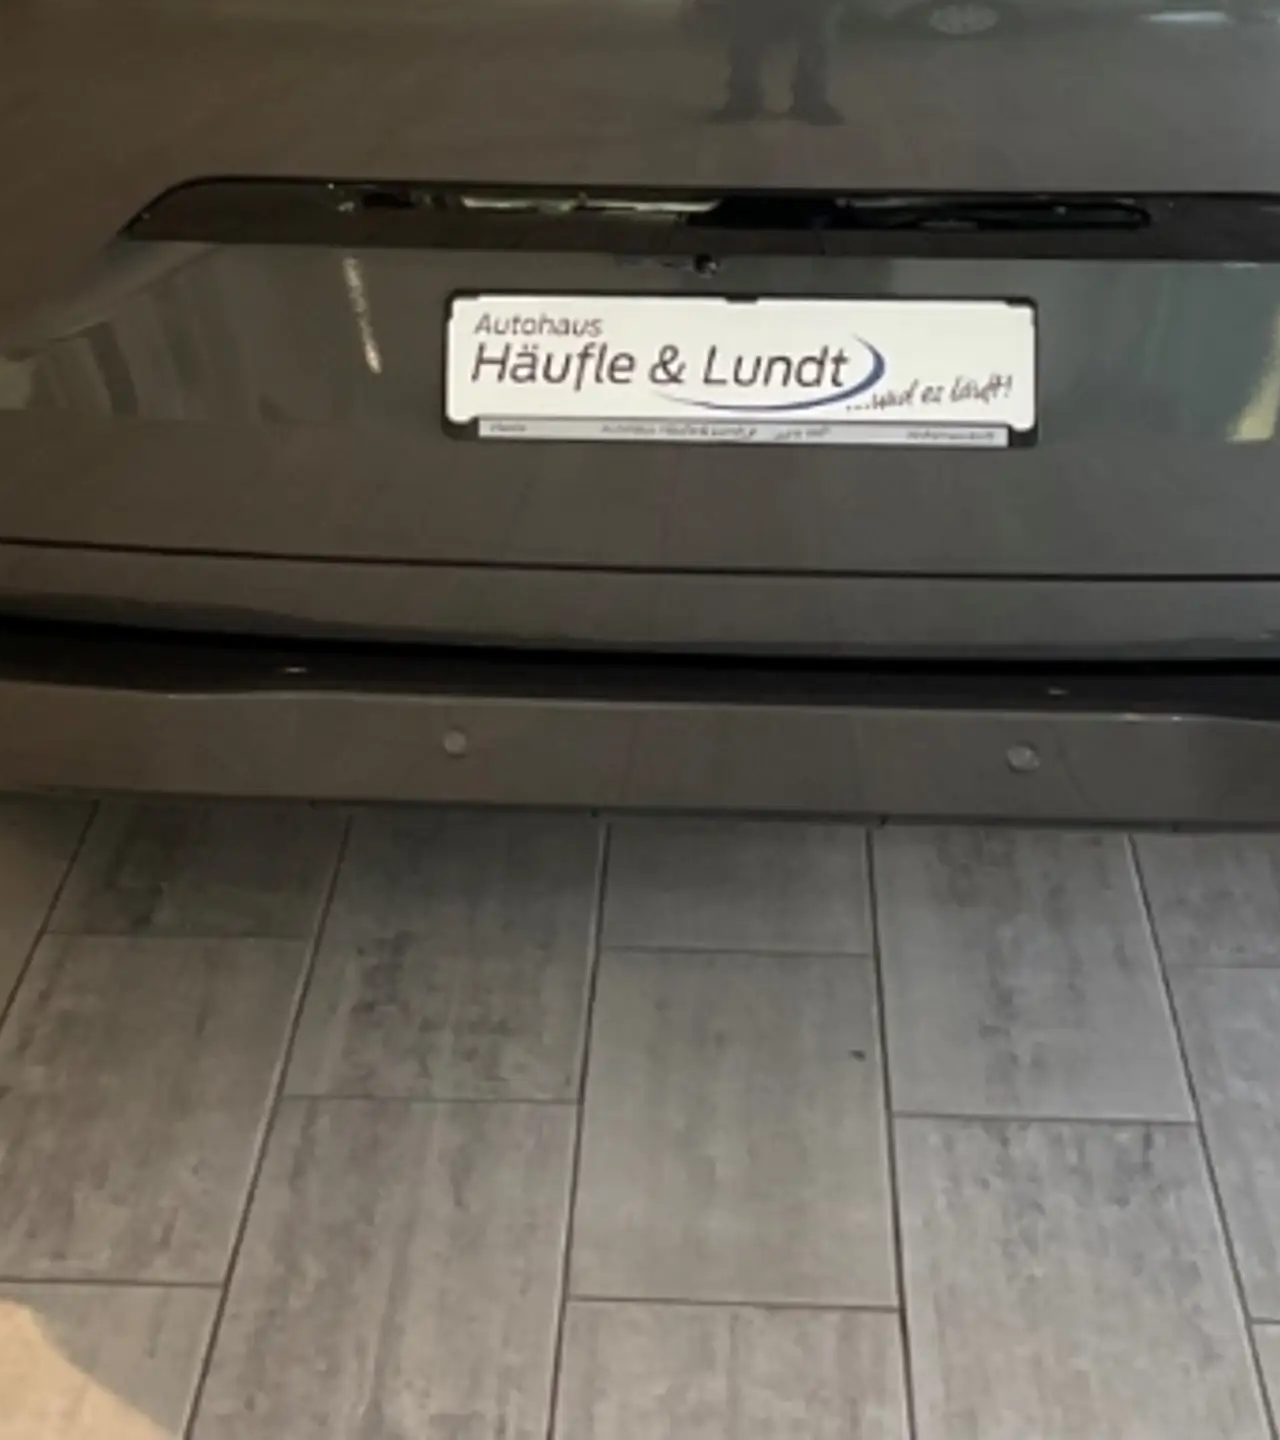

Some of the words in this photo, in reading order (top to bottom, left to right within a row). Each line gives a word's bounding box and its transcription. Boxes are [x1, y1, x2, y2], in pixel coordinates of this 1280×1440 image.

[474, 313, 604, 337] Autohaus
[471, 342, 636, 392] Häufle
[648, 343, 687, 386] &
[702, 345, 850, 388] Lundt
